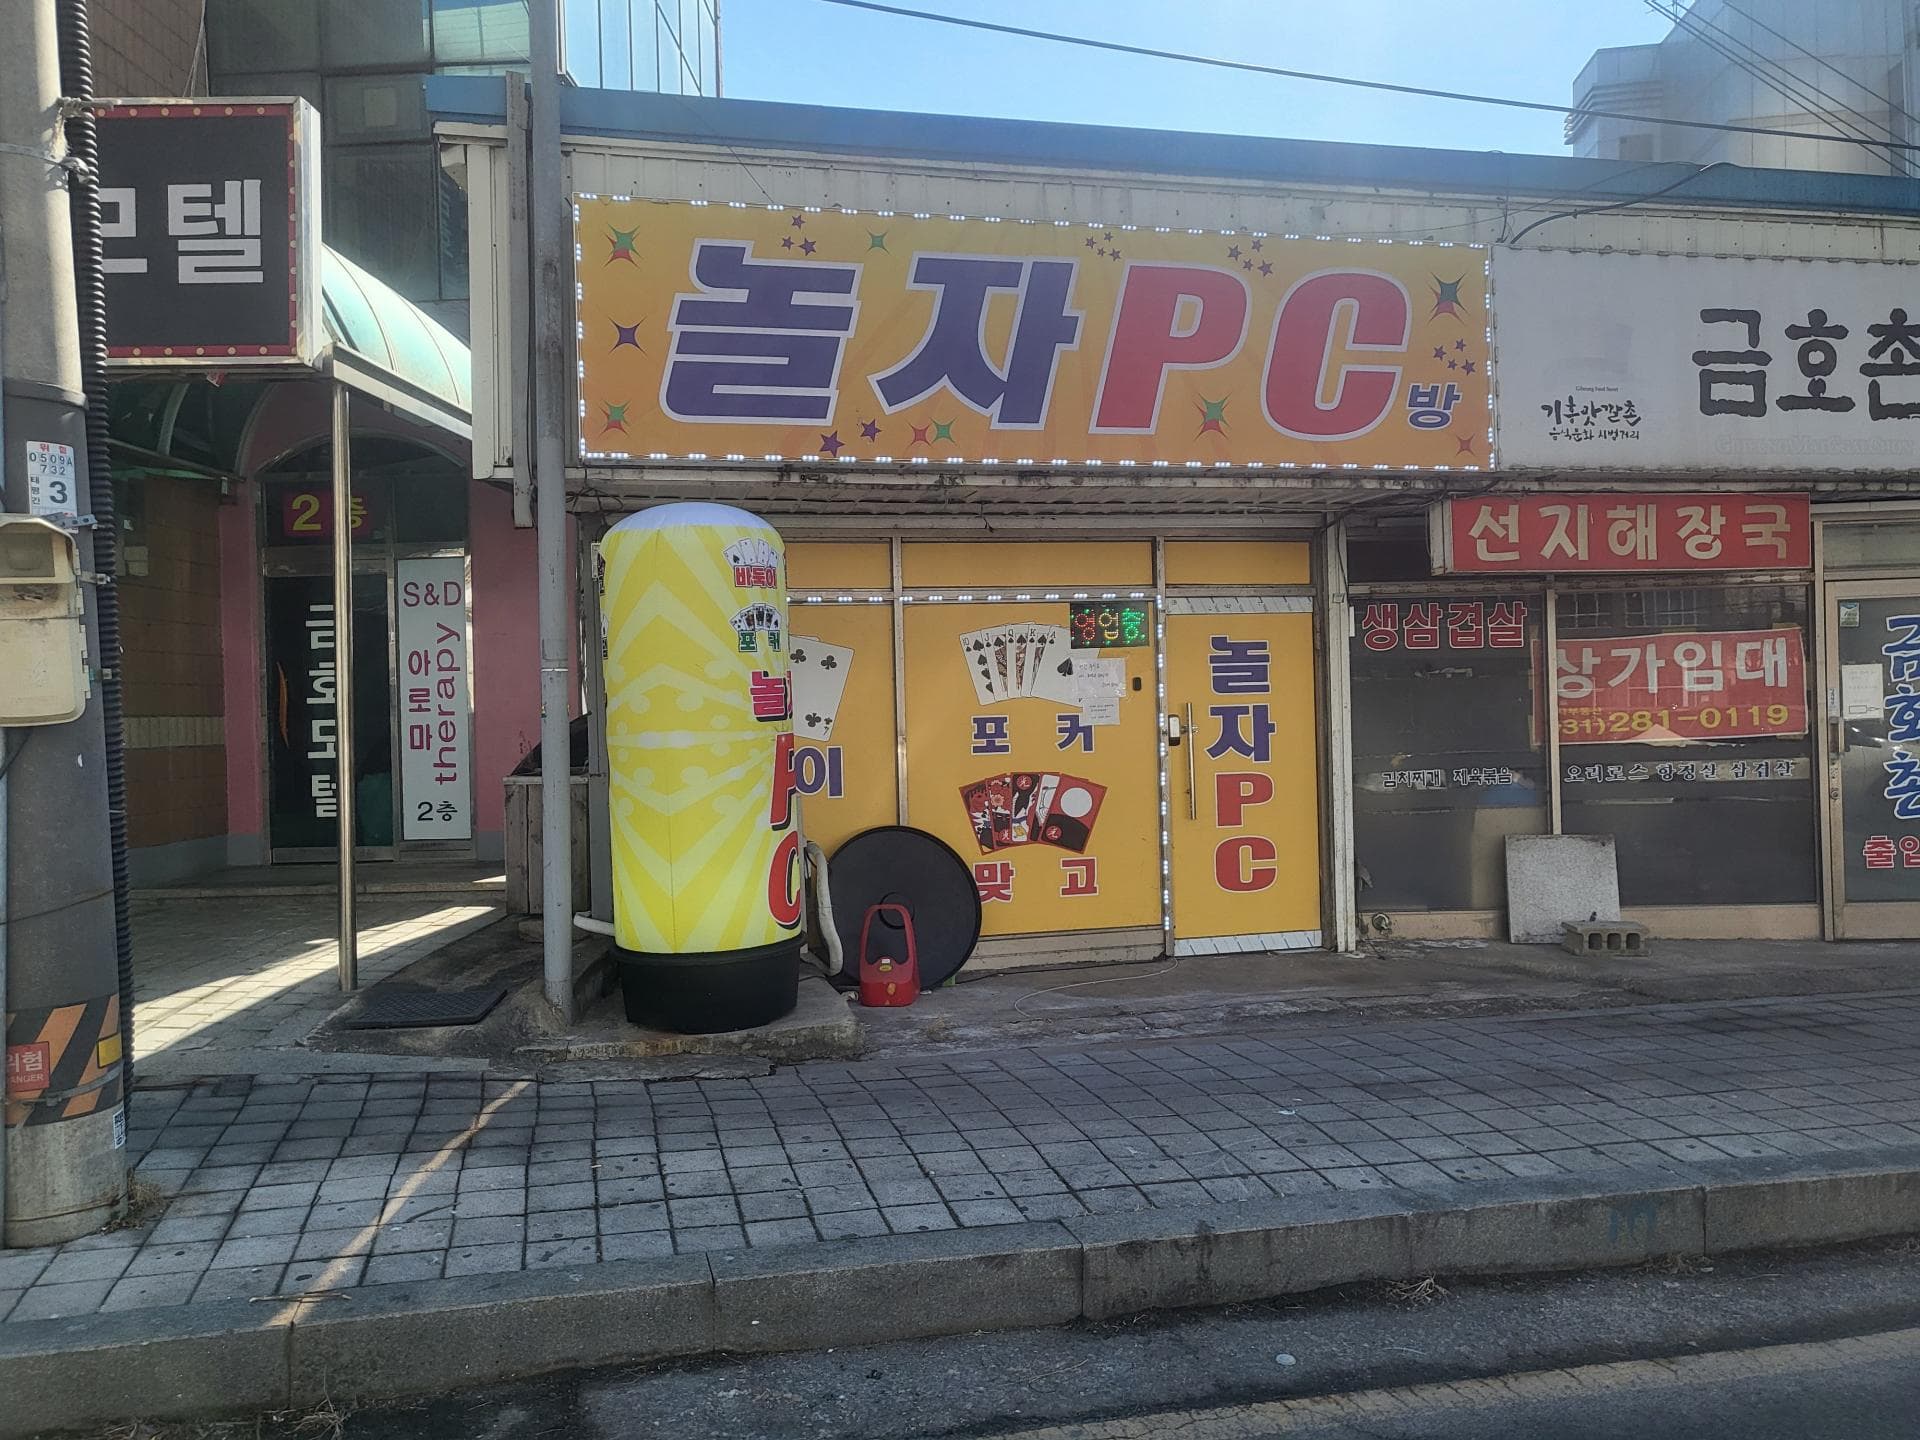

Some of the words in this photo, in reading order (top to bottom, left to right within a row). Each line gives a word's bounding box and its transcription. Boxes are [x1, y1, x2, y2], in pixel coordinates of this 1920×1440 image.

[49, 481, 68, 504] 3
[1468, 503, 1791, 562] 선지해장국
[735, 565, 778, 589] 바둑이
[403, 581, 462, 607] S&D
[1075, 611, 1141, 640] 영업중
[1362, 601, 1528, 651] 생삼겹살
[1557, 637, 1788, 699] 상가임대
[433, 622, 461, 786] therapy
[1382, 769, 1441, 789] 김치찌개
[1453, 767, 1512, 786] 제육볶음
[1564, 763, 1649, 783] 오리로스
[1656, 761, 1718, 780] 항정살
[417, 800, 458, 821] 2층
